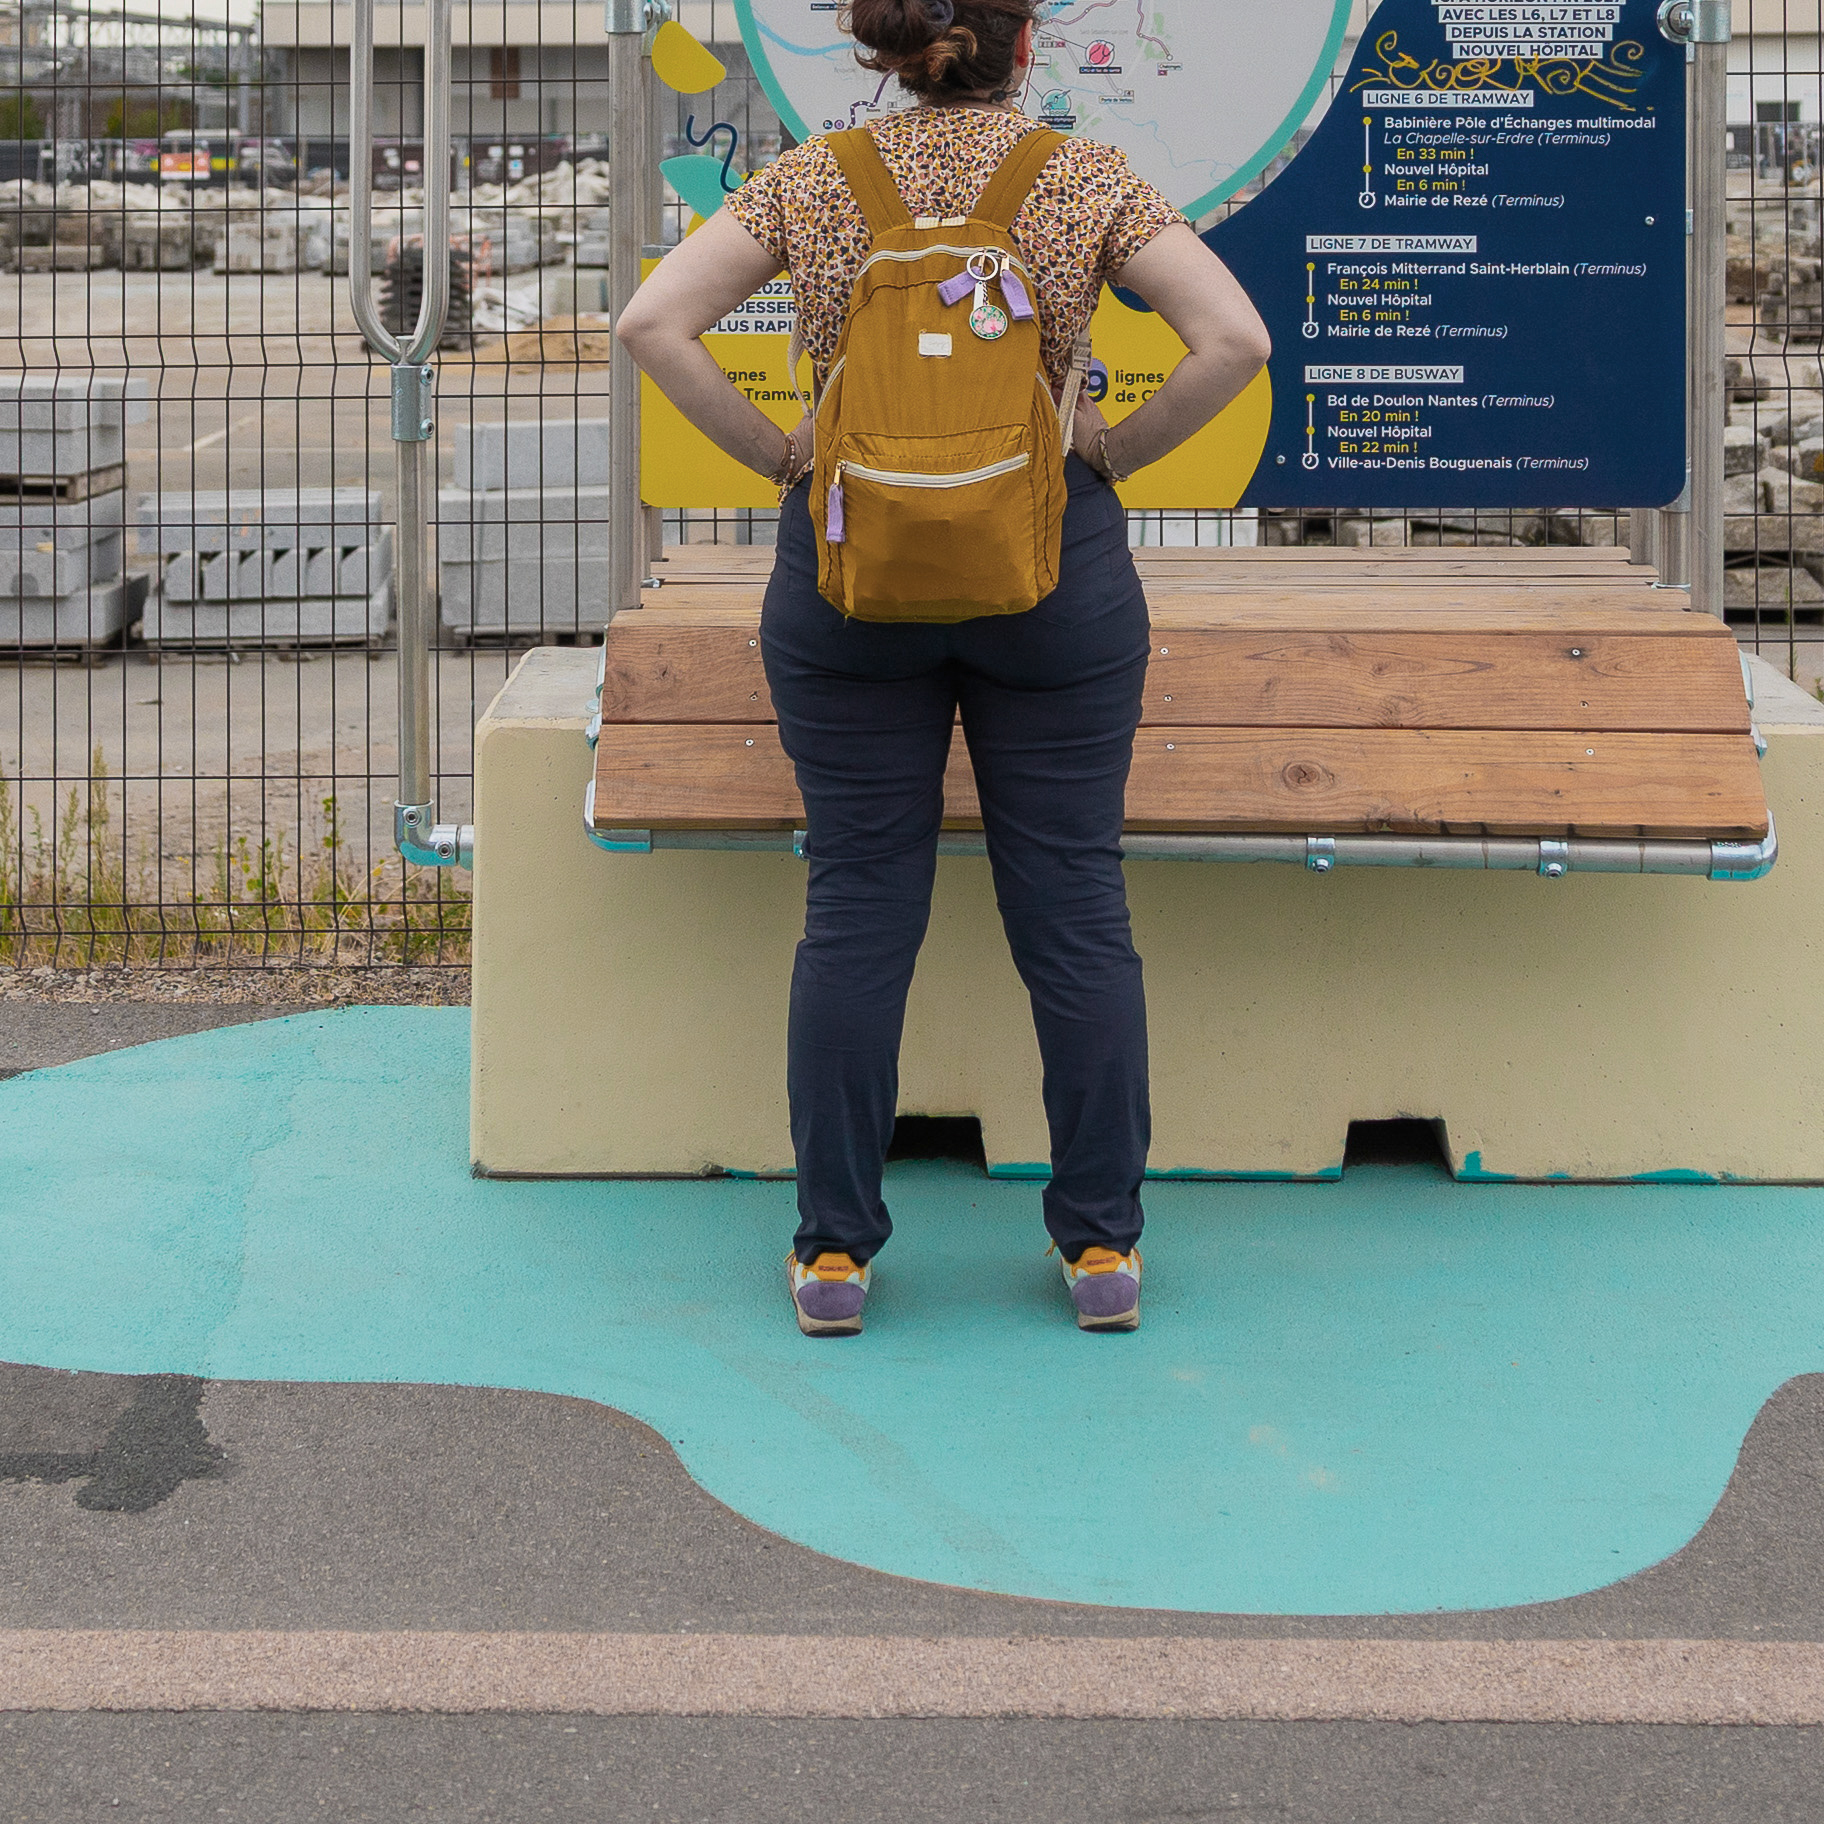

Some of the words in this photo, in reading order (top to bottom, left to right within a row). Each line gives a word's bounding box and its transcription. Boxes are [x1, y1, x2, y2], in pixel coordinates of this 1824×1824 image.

[1441, 8, 1485, 21] AVEC
[1489, 8, 1518, 21] LES
[1521, 8, 1546, 23] L6,
[1549, 8, 1569, 21] L7
[1572, 8, 1593, 21] ET
[1596, 8, 1615, 21] L8
[1451, 26, 1509, 39] DEPUIS
[1513, 26, 1534, 39] LA
[1537, 26, 1606, 39] STATION
[1459, 44, 1526, 58] NOUVEL
[1529, 41, 1599, 58] HÔPITAL
[1367, 92, 1411, 105] LIGNE
[1414, 92, 1424, 105] 6
[1428, 93, 1448, 105] DE
[1451, 92, 1530, 105] TRAMWAY
[1384, 115, 1452, 129] Babinière
[1455, 116, 1487, 129] Pôle
[1490, 113, 1573, 131] d'Échanges
[1576, 116, 1656, 129] multimodal
[1383, 131, 1403, 145] La
[1405, 131, 1535, 147] Chapelle-sur-Erdre
[1537, 131, 1611, 147] (Terminus)
[1397, 147, 1415, 160] En
[1419, 147, 1437, 160] 33
[1440, 147, 1467, 160] min
[1384, 163, 1434, 175] Nouvel
[1438, 162, 1489, 177] Hôpital
[1397, 179, 1415, 191] En
[1418, 178, 1429, 191] 6
[1432, 178, 1459, 191] min
[1384, 193, 1428, 207] Mairie
[1430, 194, 1450, 207] de
[1453, 193, 1489, 207] Rezé
[1491, 194, 1565, 209] (Terminus)
[1310, 237, 1354, 250] LIGNE
[1357, 237, 1367, 250] 7
[1371, 238, 1391, 250] DE
[1395, 238, 1473, 250] TRAMWAY
[1327, 261, 1388, 278] François
[1391, 262, 1466, 275] Mitterrand
[1469, 261, 1570, 275] Saint-Herblain
[1573, 262, 1647, 277] (Terminus)
[754, 282, 792, 295] 027
[1339, 278, 1359, 290] En
[1361, 278, 1380, 290] 24
[1383, 277, 1411, 291] min
[1327, 293, 1377, 306] Nouvel
[1381, 293, 1432, 308] Hôpital
[1339, 309, 1359, 321] En
[1361, 309, 1372, 321] 6
[1375, 308, 1401, 321] min
[1327, 324, 1371, 337] Mairie
[1374, 324, 1393, 337] de
[1396, 324, 1431, 337] Rezé
[1434, 324, 1508, 339] (Terminus)
[1115, 369, 1165, 386] lignes
[1309, 368, 1353, 380] LIGNE
[1356, 368, 1366, 380] 8
[1369, 368, 1390, 380] DE
[1394, 368, 1460, 380] BUSWAY
[1115, 389, 1137, 403] de
[1327, 394, 1347, 407] Bd
[1350, 394, 1370, 407] de
[1373, 394, 1424, 407] Doulon
[1427, 394, 1479, 407] Nantes
[1481, 394, 1555, 409] (Terminus)
[1339, 410, 1359, 422] En
[1361, 410, 1381, 422] 20
[1385, 409, 1411, 422] min
[1327, 425, 1377, 438] Nouvel
[1381, 425, 1432, 440] Hôpital
[1339, 441, 1358, 453] En
[1361, 441, 1380, 453] 22
[1383, 440, 1410, 453] min
[1327, 456, 1426, 469] Ville-au-Denis
[1429, 456, 1513, 471] Bouguenais
[1515, 456, 1589, 471] (Terminus)
